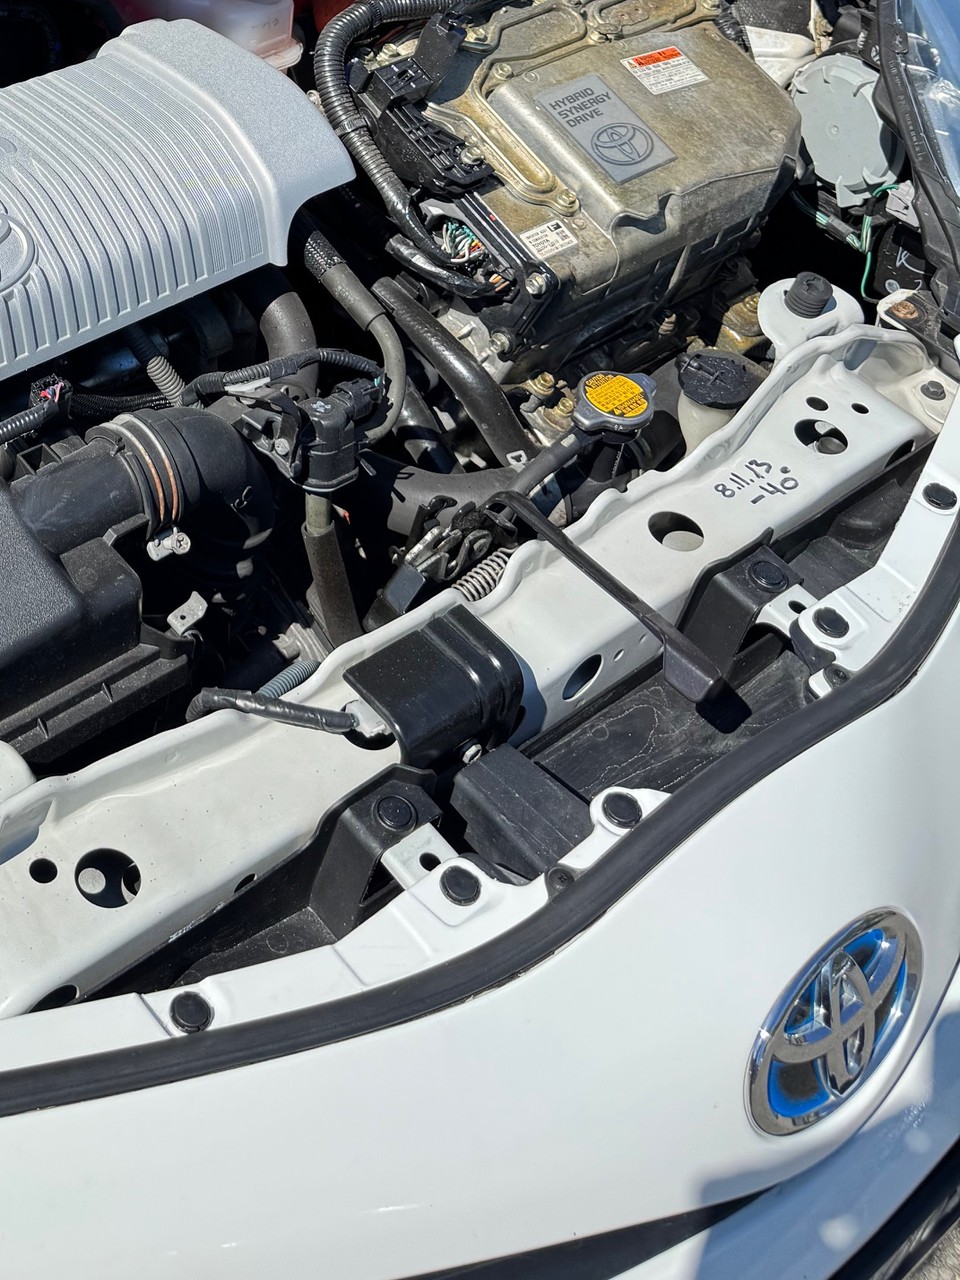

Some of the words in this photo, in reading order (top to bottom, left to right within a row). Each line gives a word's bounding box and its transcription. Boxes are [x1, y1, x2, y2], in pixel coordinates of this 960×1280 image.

[549, 87, 595, 111] HYBRID
[557, 91, 612, 120] SYNERGY
[565, 107, 604, 128] DRIVE
